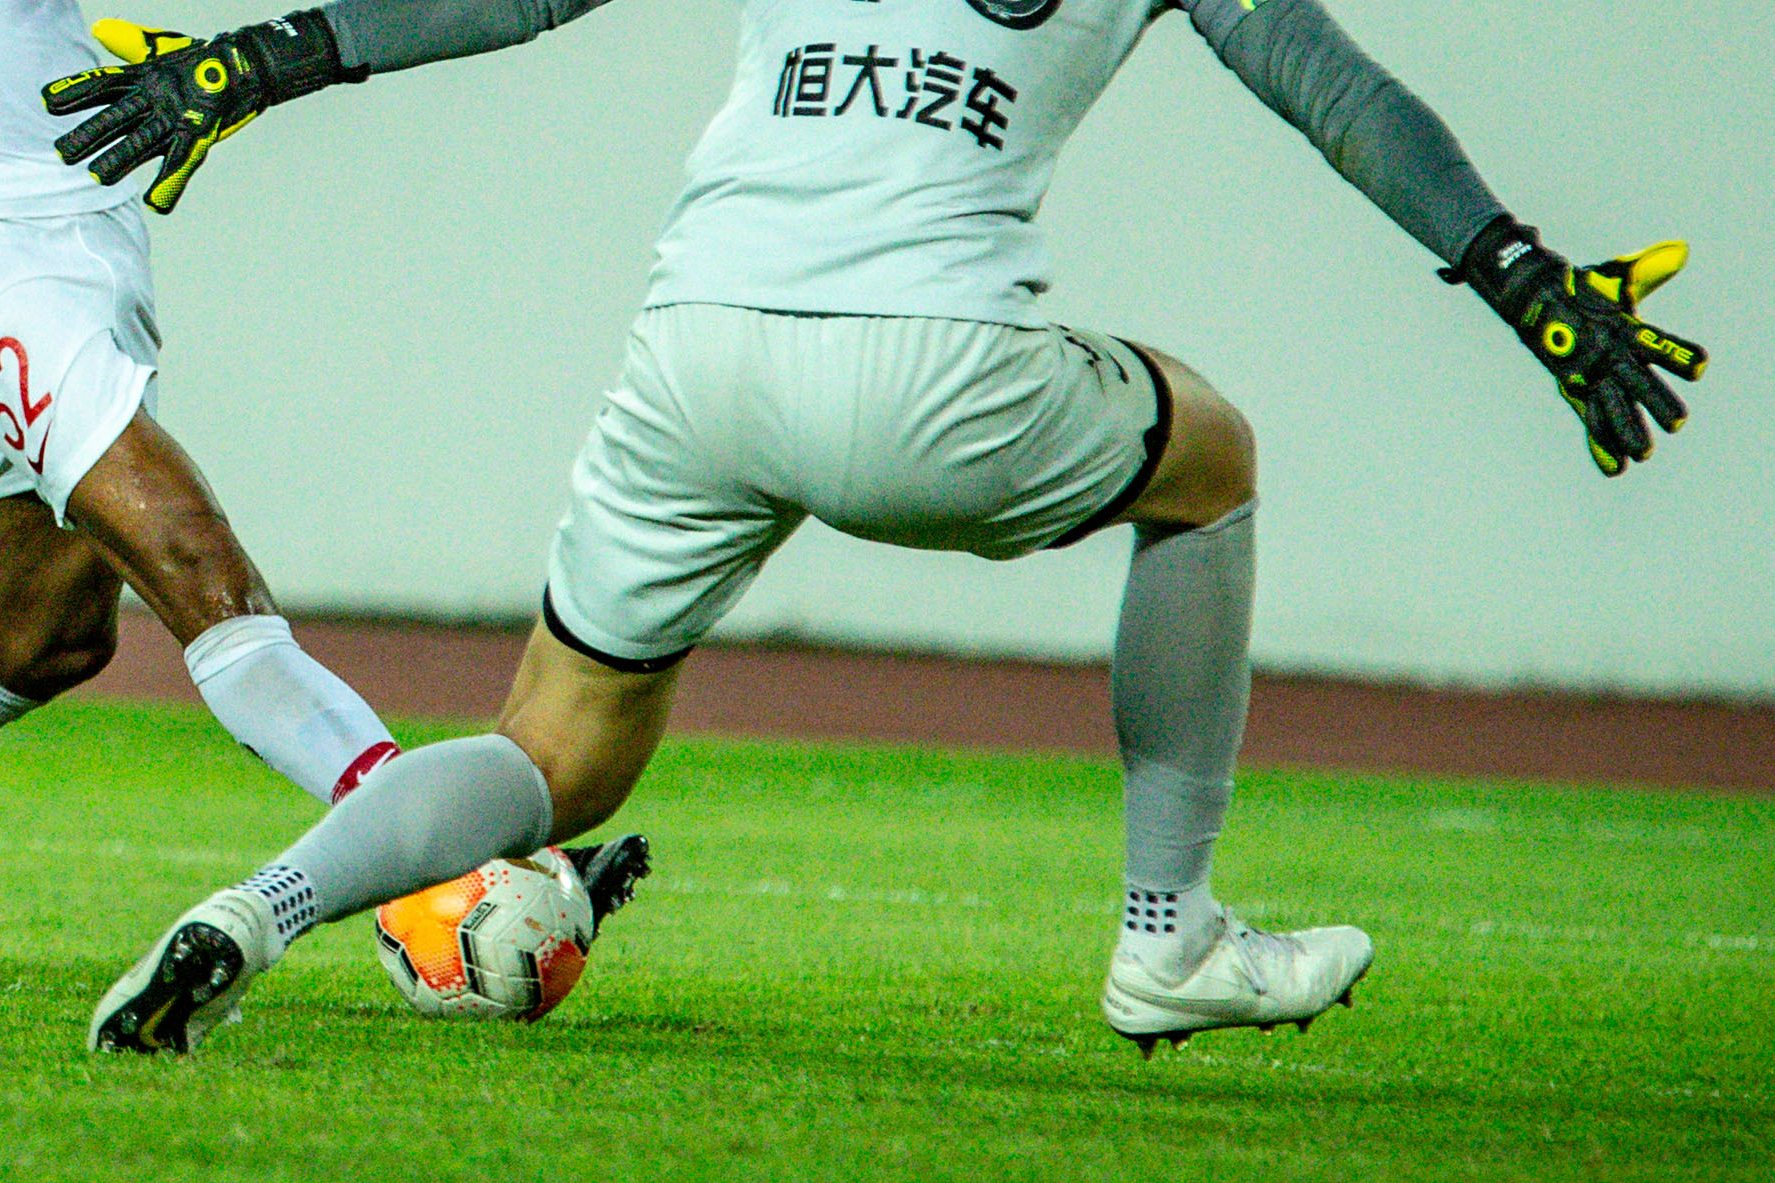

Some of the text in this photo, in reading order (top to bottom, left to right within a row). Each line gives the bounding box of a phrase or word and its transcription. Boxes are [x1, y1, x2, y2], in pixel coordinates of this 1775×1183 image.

[772, 42, 1019, 152] 恒大汽车
[1638, 328, 1695, 365] ELITE
